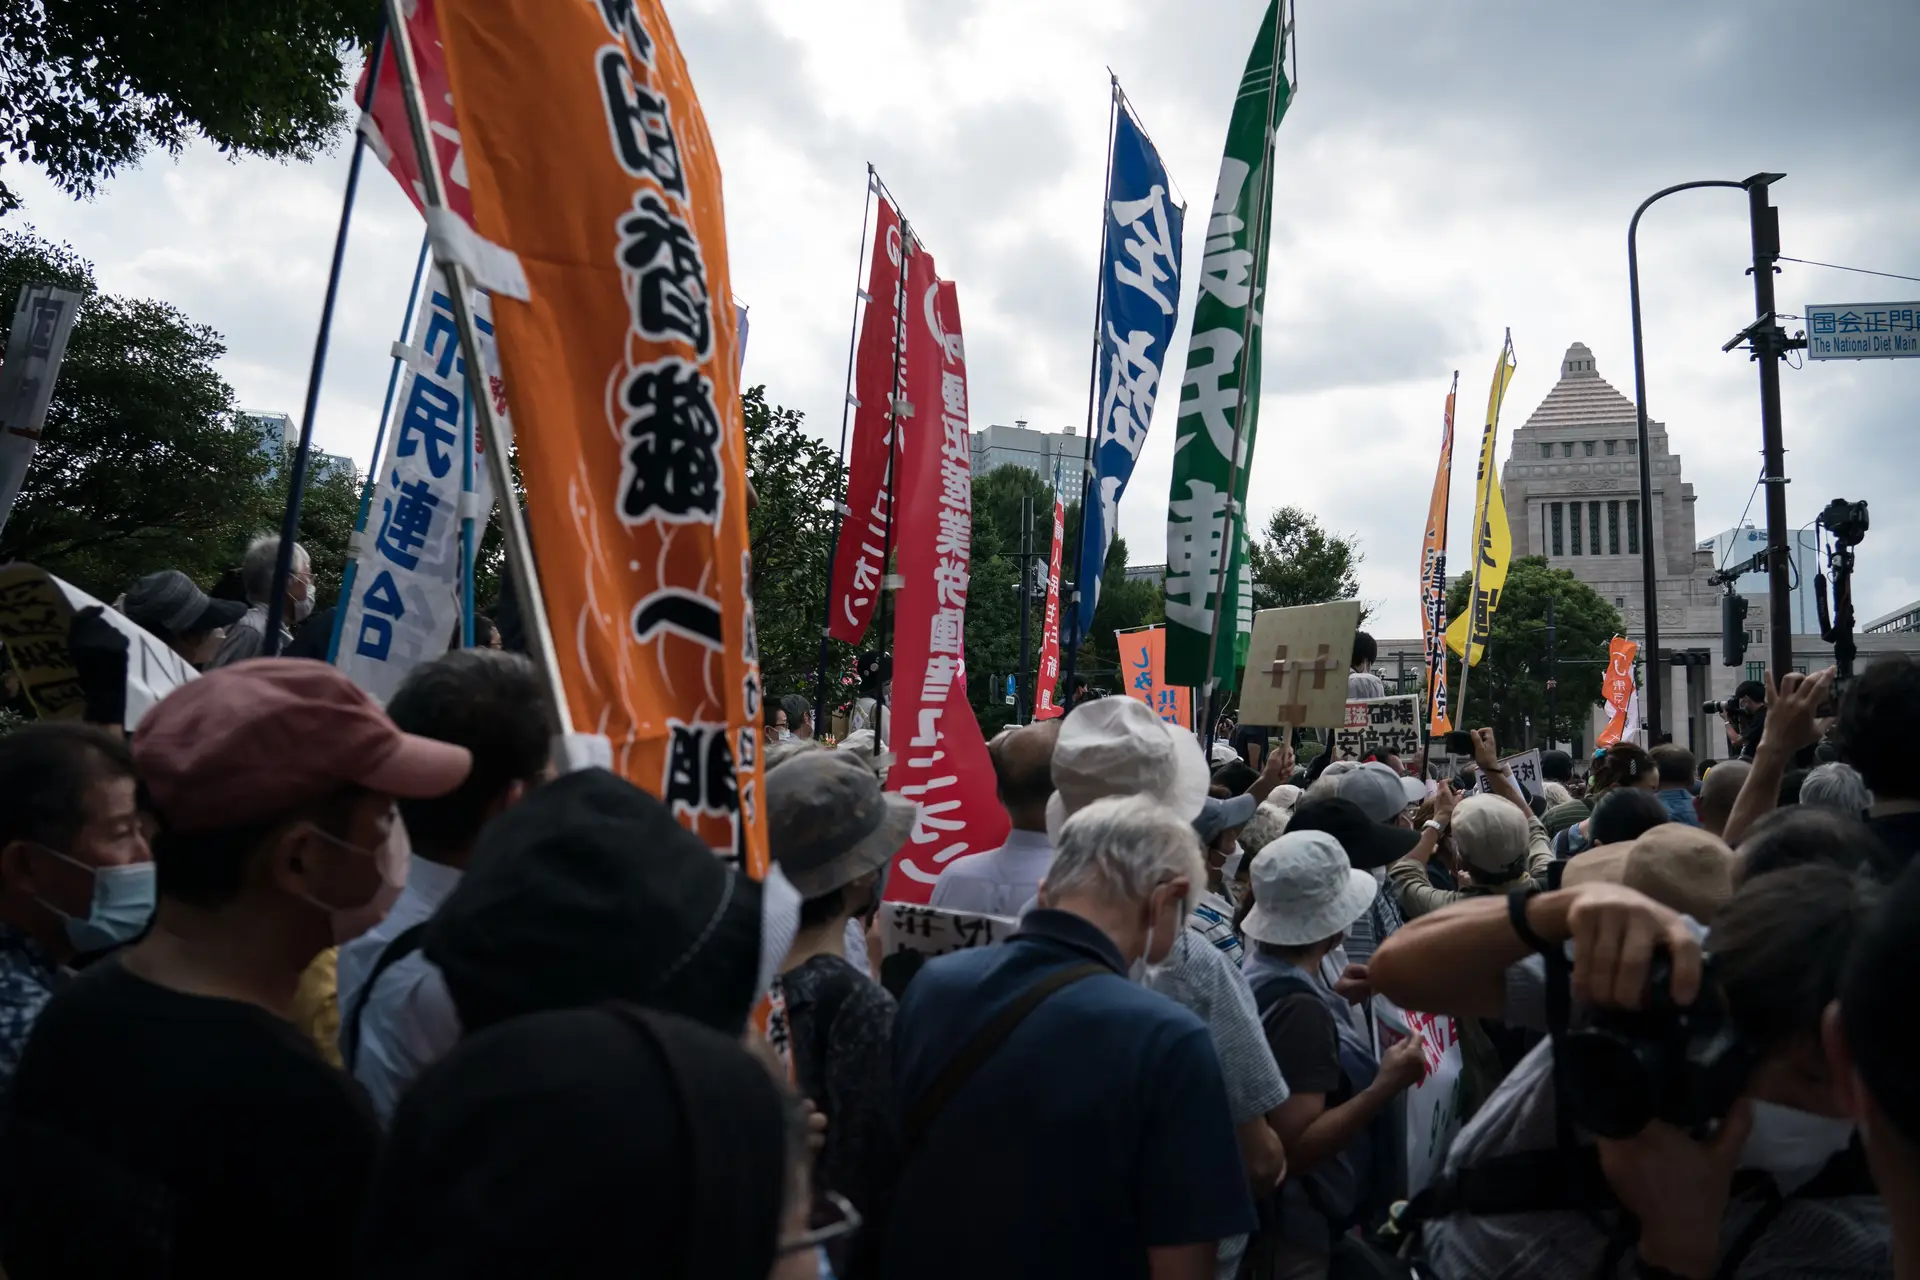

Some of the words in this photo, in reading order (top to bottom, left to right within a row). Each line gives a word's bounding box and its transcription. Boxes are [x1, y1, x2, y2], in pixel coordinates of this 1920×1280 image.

[1813, 309, 1920, 334] 国会正門
[1814, 337, 1831, 352] The
[1833, 336, 1871, 352] National
[1874, 336, 1892, 352] Diet
[1895, 335, 1917, 351] Main
[1337, 726, 1418, 757] 安倍政治
